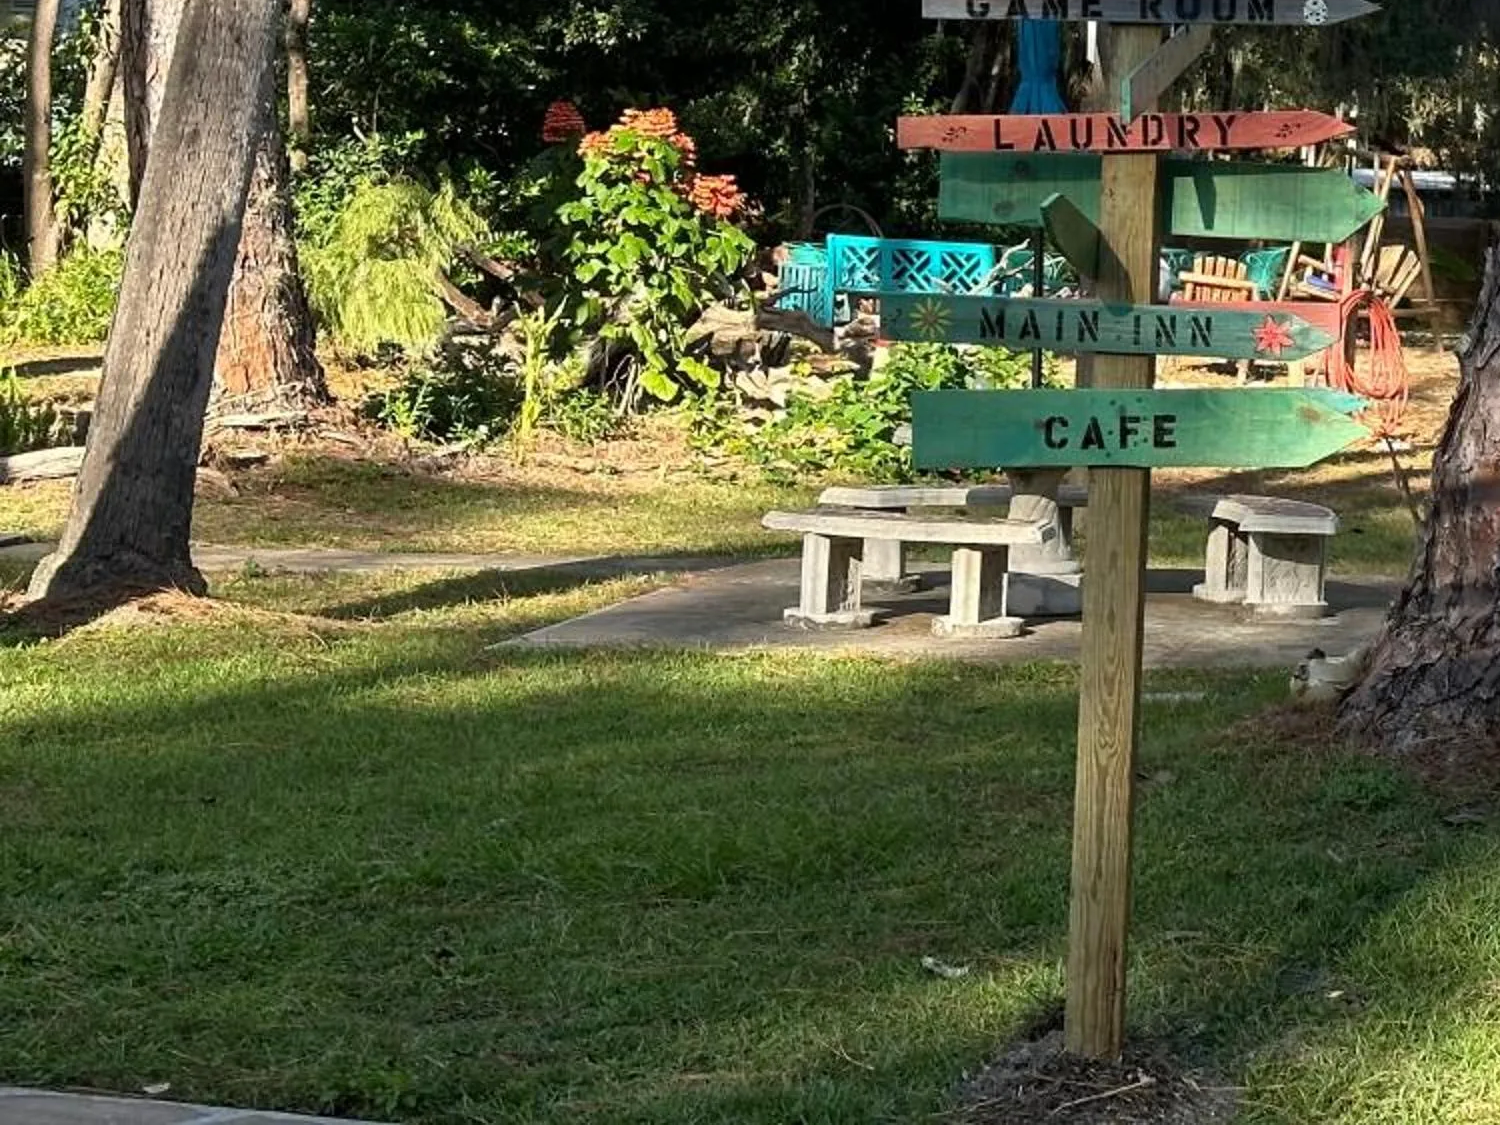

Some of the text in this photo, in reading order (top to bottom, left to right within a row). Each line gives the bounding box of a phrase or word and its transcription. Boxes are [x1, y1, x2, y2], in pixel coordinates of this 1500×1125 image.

[994, 115, 1236, 150] LAUNDRY
[979, 307, 1213, 348] MAIN INN
[1043, 414, 1177, 449] CAFE
